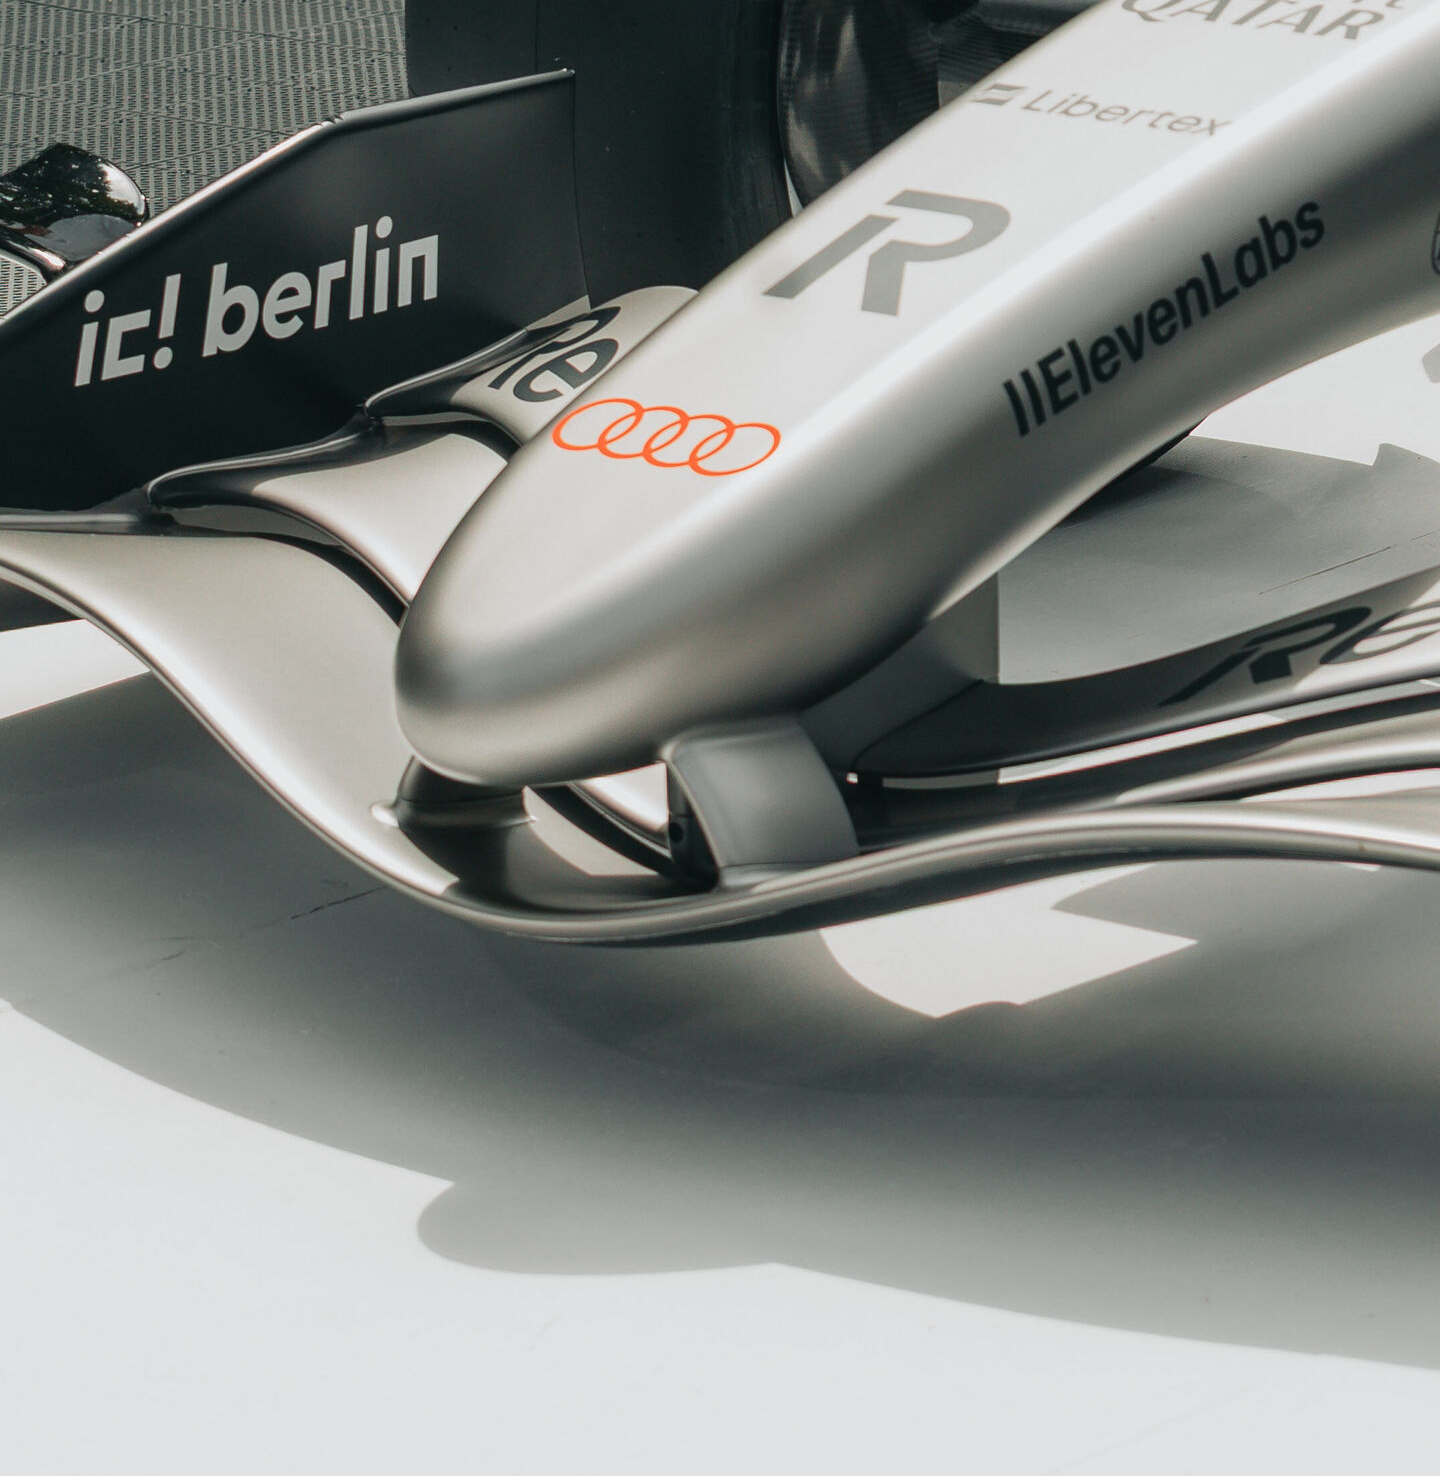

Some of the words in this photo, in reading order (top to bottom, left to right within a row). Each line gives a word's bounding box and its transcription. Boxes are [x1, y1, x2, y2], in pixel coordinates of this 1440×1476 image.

[1021, 89, 1235, 136] Libertex
[73, 273, 182, 388] ic!
[201, 215, 440, 359] berlin
